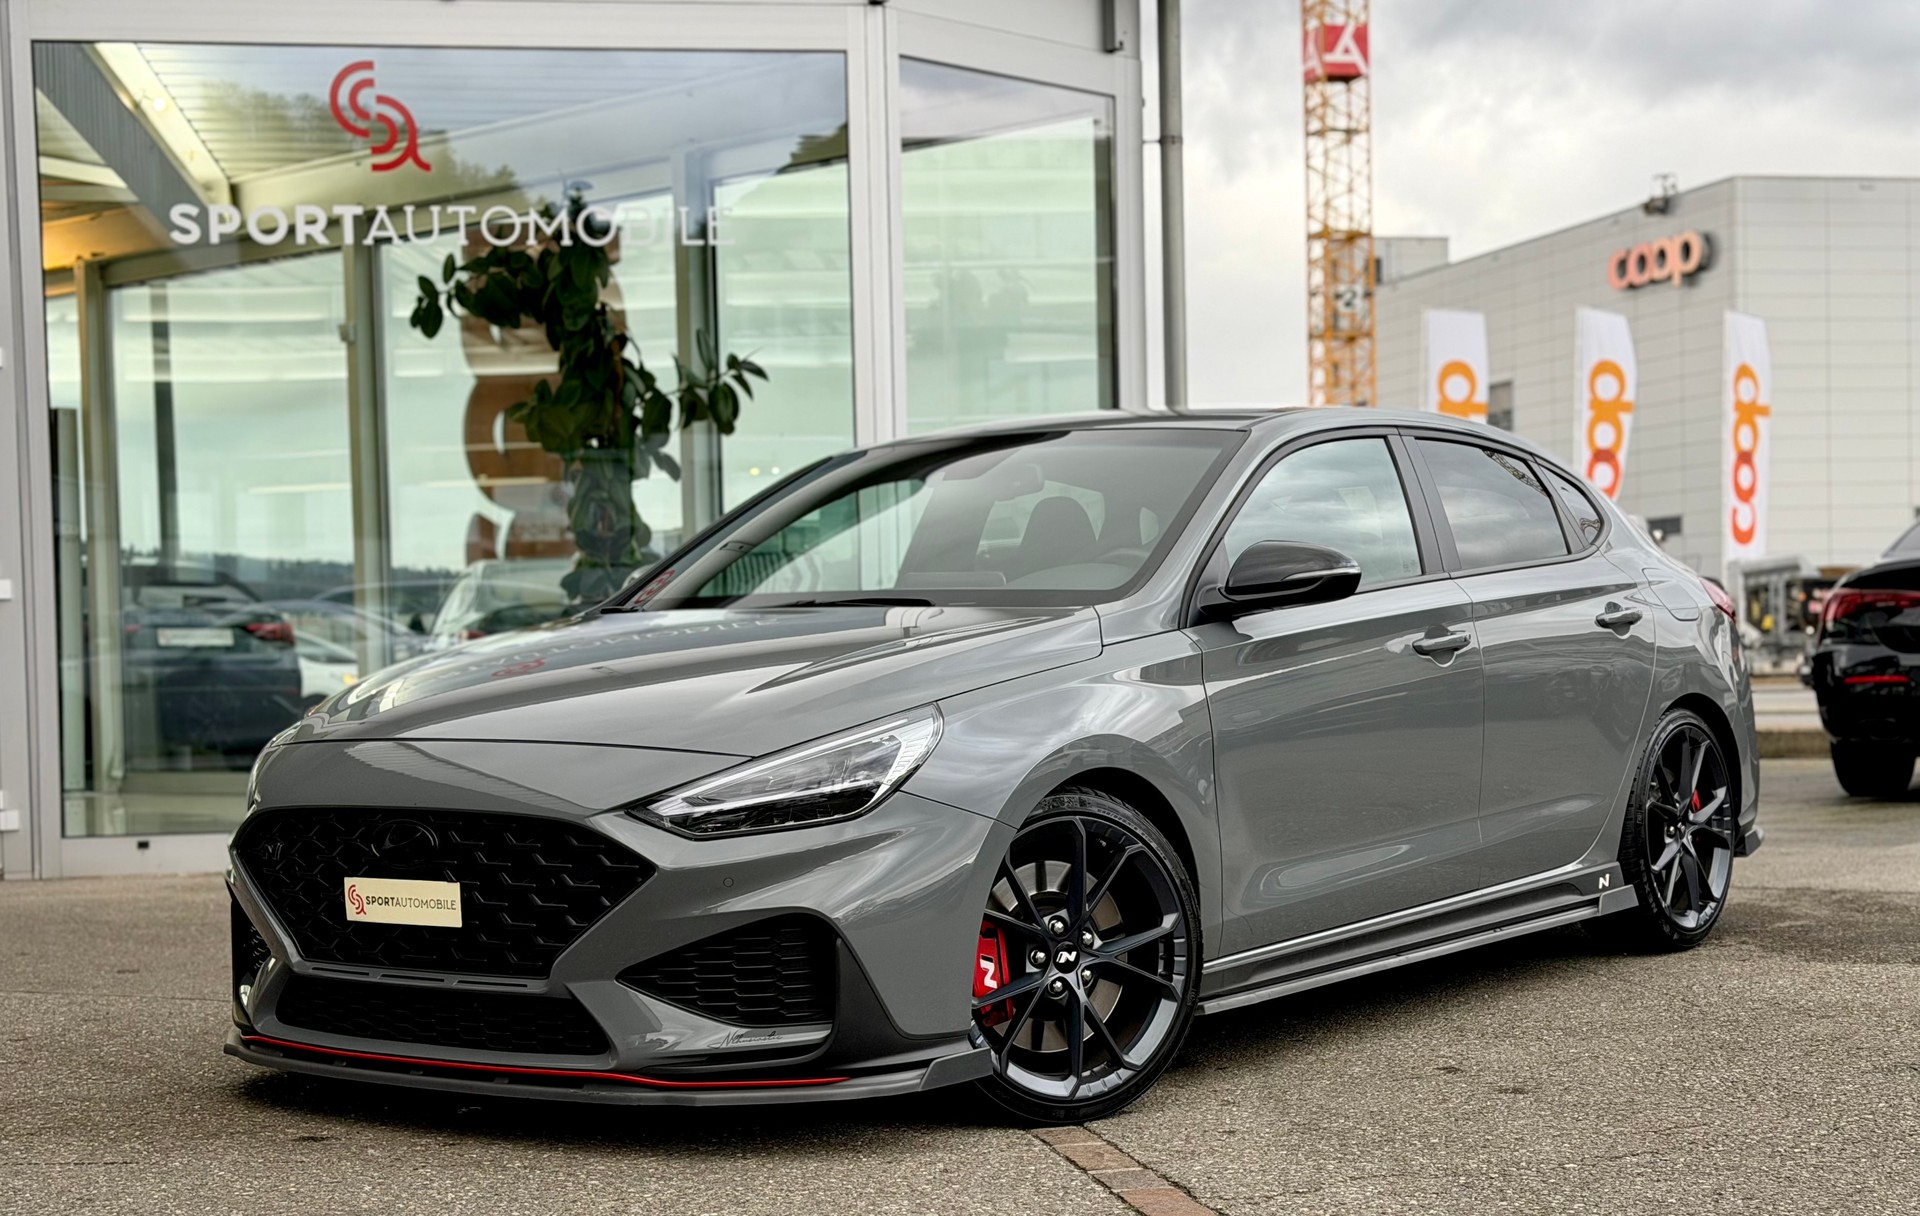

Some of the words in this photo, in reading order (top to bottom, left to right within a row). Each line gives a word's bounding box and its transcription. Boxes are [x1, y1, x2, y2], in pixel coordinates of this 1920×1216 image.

[169, 203, 735, 247] SPORTAUTOMOBILE
[1607, 230, 1703, 290] coop
[1587, 359, 1635, 501] oop
[1732, 361, 1771, 546] coop
[365, 895, 457, 911] SPORTAUTOMOBILE
[1598, 873, 1610, 890] N
